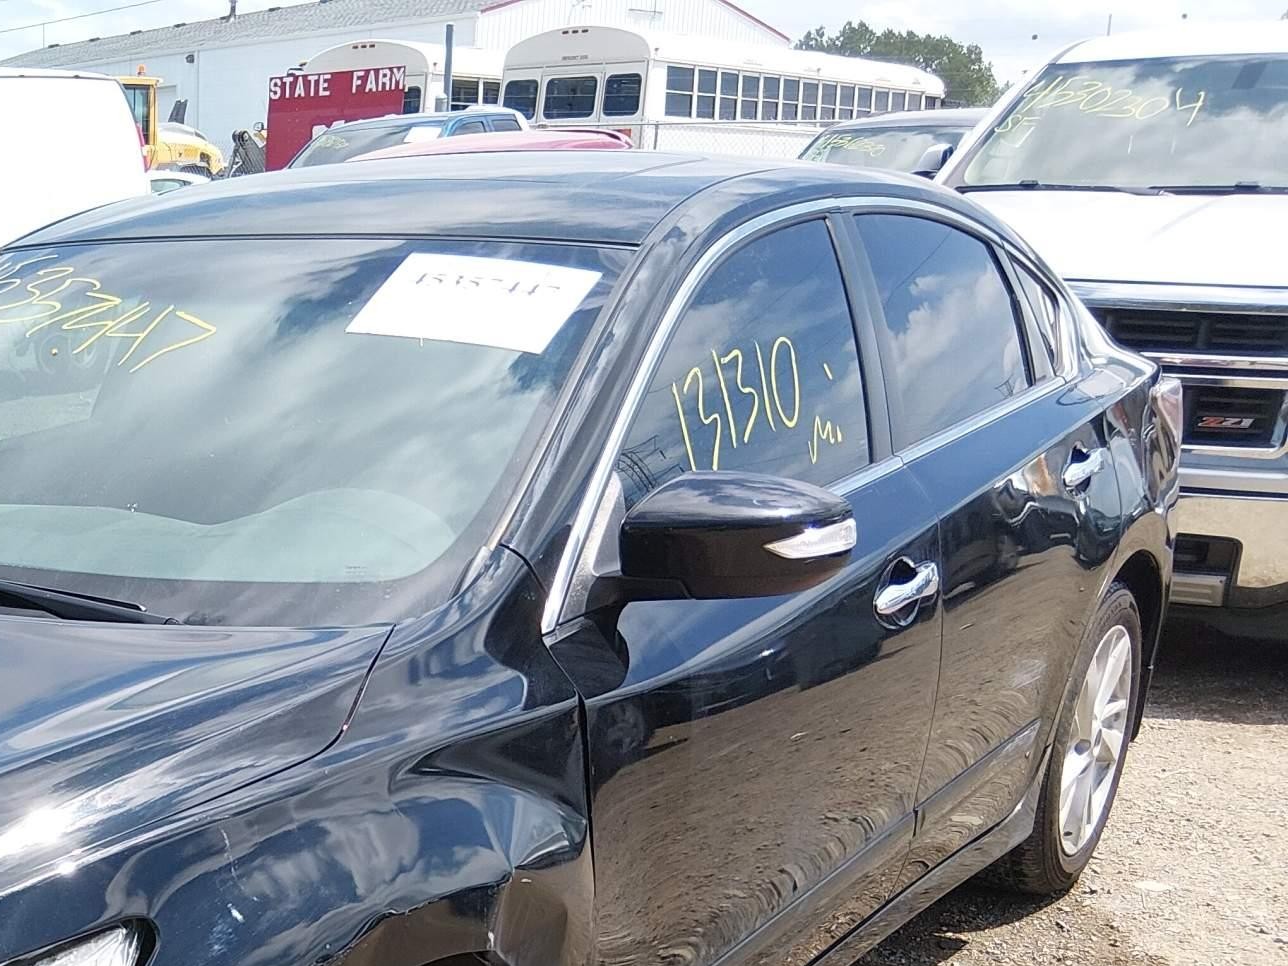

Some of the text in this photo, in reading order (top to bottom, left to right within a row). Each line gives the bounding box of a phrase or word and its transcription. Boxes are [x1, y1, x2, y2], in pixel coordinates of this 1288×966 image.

[270, 67, 406, 99] STATE FARM
[672, 336, 800, 472] 131310
[1197, 416, 1255, 429] Z71
